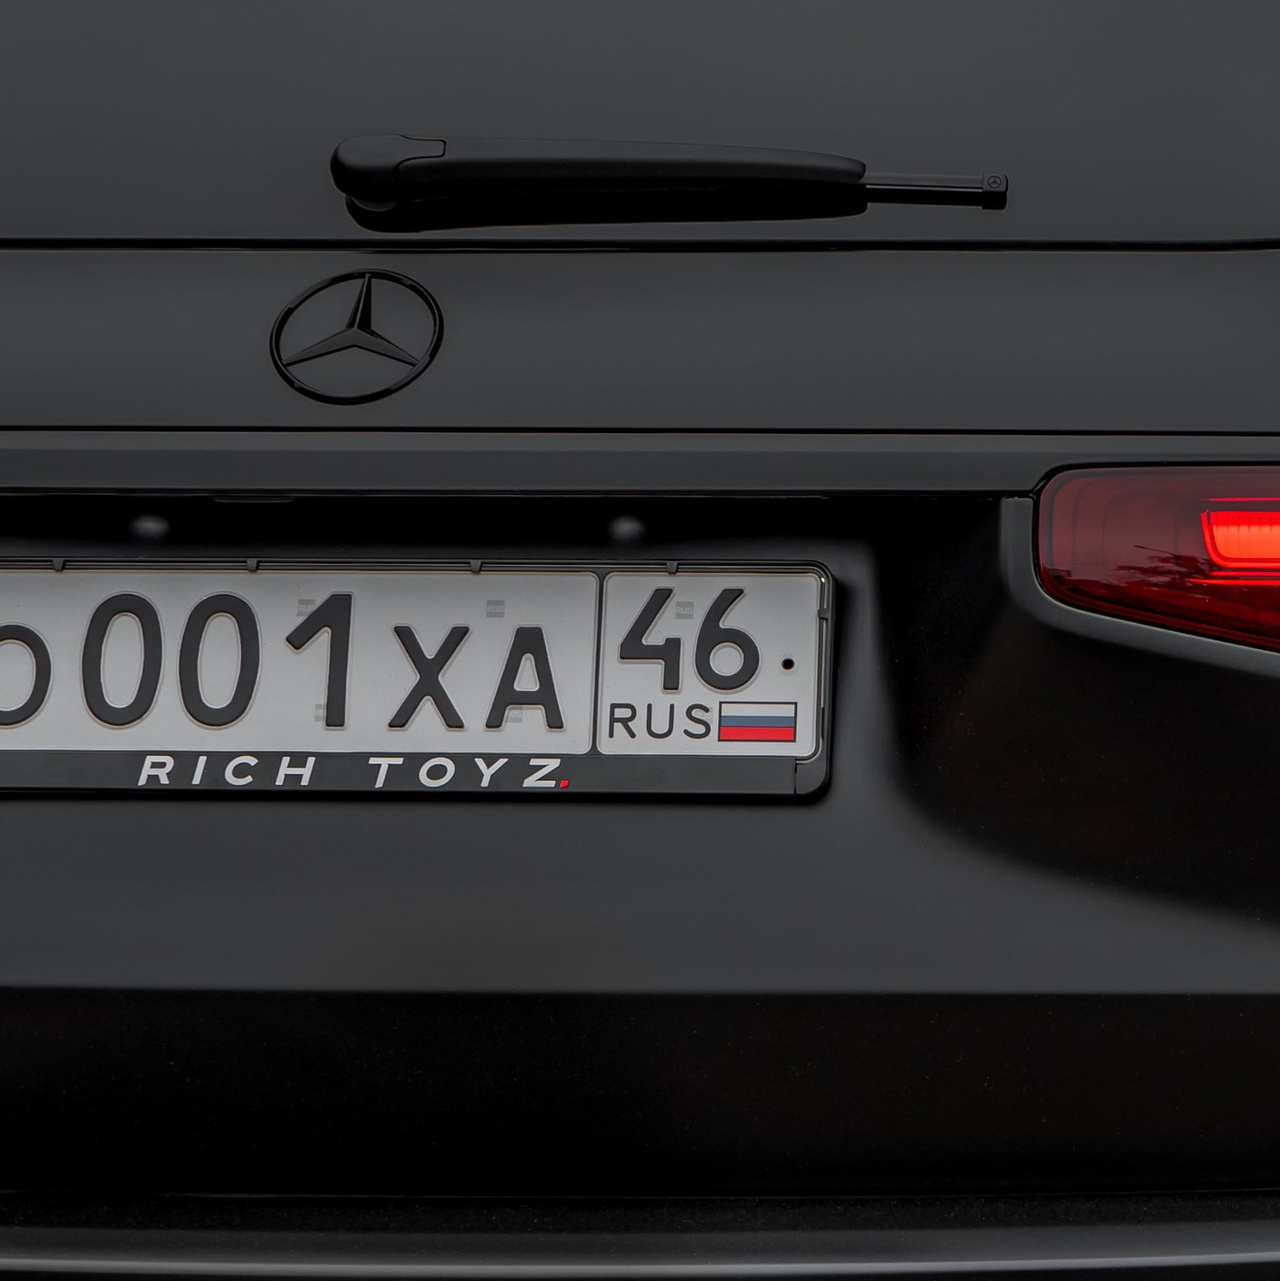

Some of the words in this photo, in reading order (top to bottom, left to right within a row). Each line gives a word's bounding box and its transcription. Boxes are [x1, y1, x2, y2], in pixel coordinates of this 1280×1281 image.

[620, 588, 760, 691] 46
[608, 703, 712, 739] RUS
[137, 755, 316, 787] RICH
